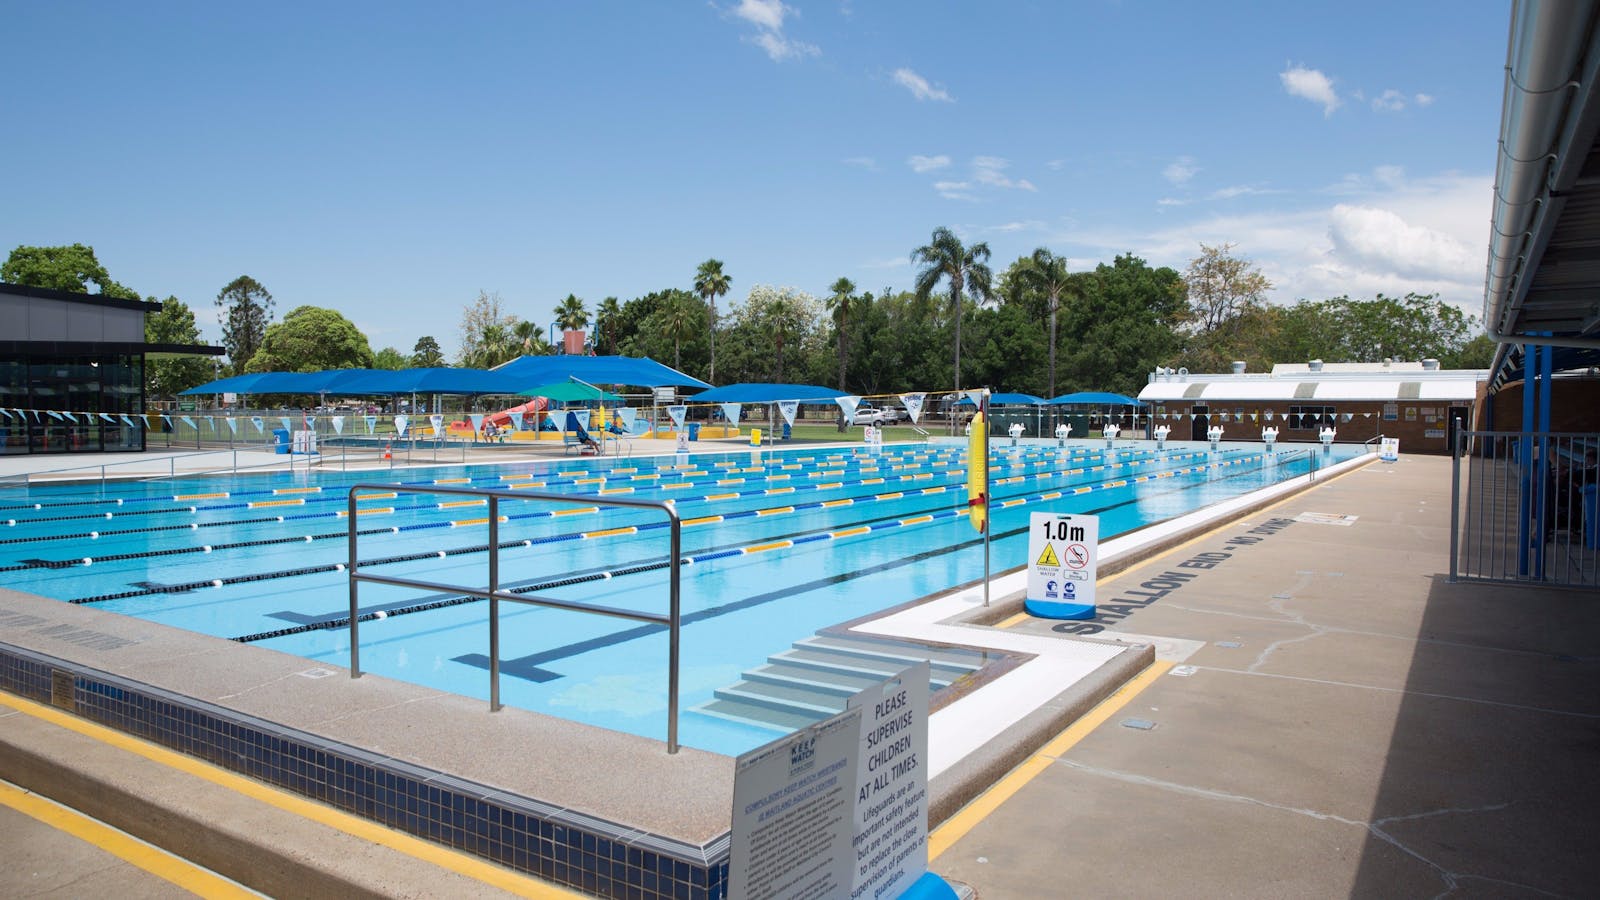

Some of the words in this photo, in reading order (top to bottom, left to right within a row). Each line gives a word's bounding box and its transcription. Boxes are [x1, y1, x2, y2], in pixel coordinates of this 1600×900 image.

[1051, 571, 1199, 635] SHALLOW
[1176, 552, 1232, 570] END
[1225, 535, 1264, 546] NO
[1246, 517, 1297, 535] DIVING
[875, 690, 906, 720] PLEASE
[791, 737, 815, 755] KEEP
[867, 710, 912, 749] SUPERVISE
[868, 733, 911, 771] CHILDREN
[791, 748, 815, 765] WATCH
[859, 782, 871, 804] AT
[873, 772, 889, 794] ALL
[891, 753, 918, 781] TIMES.
[852, 817, 884, 848] important
[885, 804, 903, 824] safety
[905, 789, 924, 808] feature
[863, 793, 895, 822] Lifeguards
[896, 786, 906, 799] are
[907, 781, 914, 792] an
[858, 845, 869, 861] but
[870, 838, 880, 851] are
[882, 828, 892, 842] not
[893, 805, 918, 833] intended
[860, 864, 867, 876] to
[868, 846, 891, 869] replace
[892, 838, 902, 851] the
[903, 826, 916, 842] close
[850, 866, 887, 900] supervision
[888, 856, 895, 870] of
[896, 841, 917, 867] parents
[918, 835, 925, 846] or
